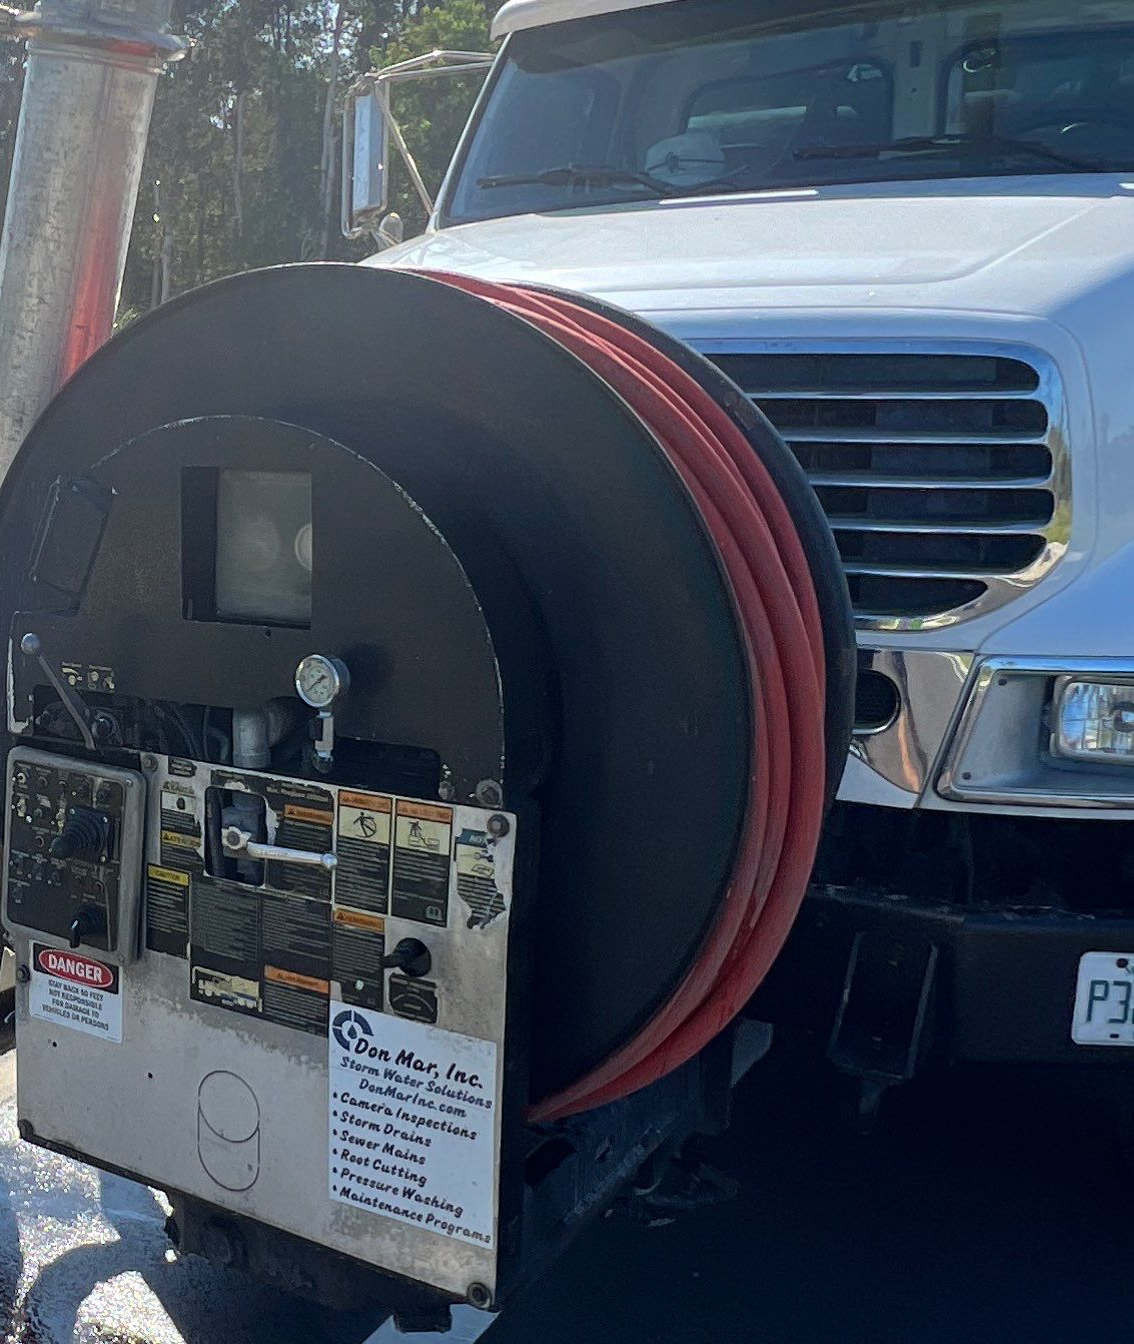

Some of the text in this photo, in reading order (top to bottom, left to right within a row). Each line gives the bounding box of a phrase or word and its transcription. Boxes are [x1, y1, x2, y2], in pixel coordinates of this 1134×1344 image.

[48, 954, 103, 983] DANGER
[48, 979, 62, 989] STAY
[63, 984, 79, 994] BACK
[90, 991, 104, 1002] FEET
[48, 988, 61, 997] NOT
[52, 998, 64, 1007] FOR
[65, 1001, 90, 1016] DAMAGE
[42, 1004, 70, 1018] VEHICLES
[81, 1015, 109, 1031] PERSONS
[354, 1037, 484, 1089] Don Mar, Inc.
[340, 1056, 493, 1109] Storm Water Solutions
[359, 1078, 467, 1118] DonMarInc.com
[340, 1092, 478, 1140] Camera Inspections
[340, 1110, 432, 1147] Storm Drains
[340, 1130, 427, 1165] Sewer Mains
[340, 1149, 428, 1187] Root Cutting
[340, 1167, 464, 1218] Pressure Washing
[339, 1186, 492, 1244] Maintenance Programs
